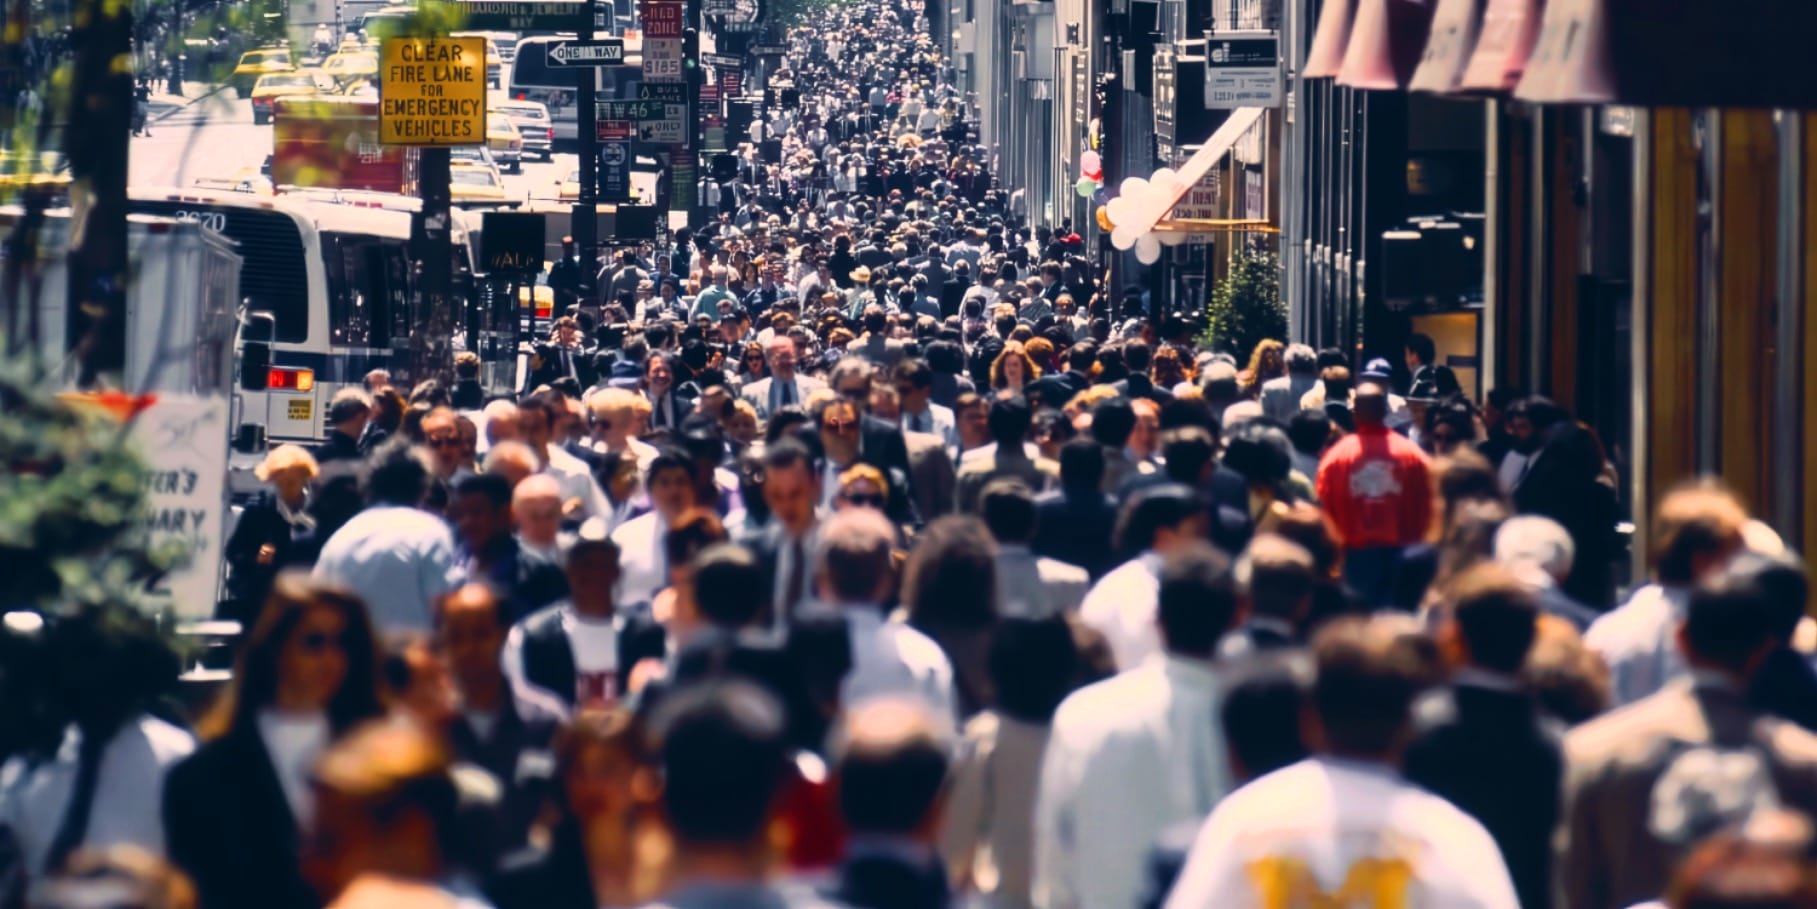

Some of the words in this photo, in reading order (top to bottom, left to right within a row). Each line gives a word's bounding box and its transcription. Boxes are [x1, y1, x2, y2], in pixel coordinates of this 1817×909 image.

[510, 16, 534, 28] WAY
[647, 22, 678, 34] ZONE
[401, 44, 462, 62] CLEAR
[557, 48, 579, 58] ONE
[595, 47, 617, 57] WAY
[390, 66, 426, 82] FIRE
[434, 66, 473, 82] LANE
[421, 85, 443, 96] FOR
[384, 99, 480, 116] EMERGENCY
[614, 103, 625, 118] W
[628, 103, 648, 118] 46
[394, 120, 472, 136] VEHICLES
